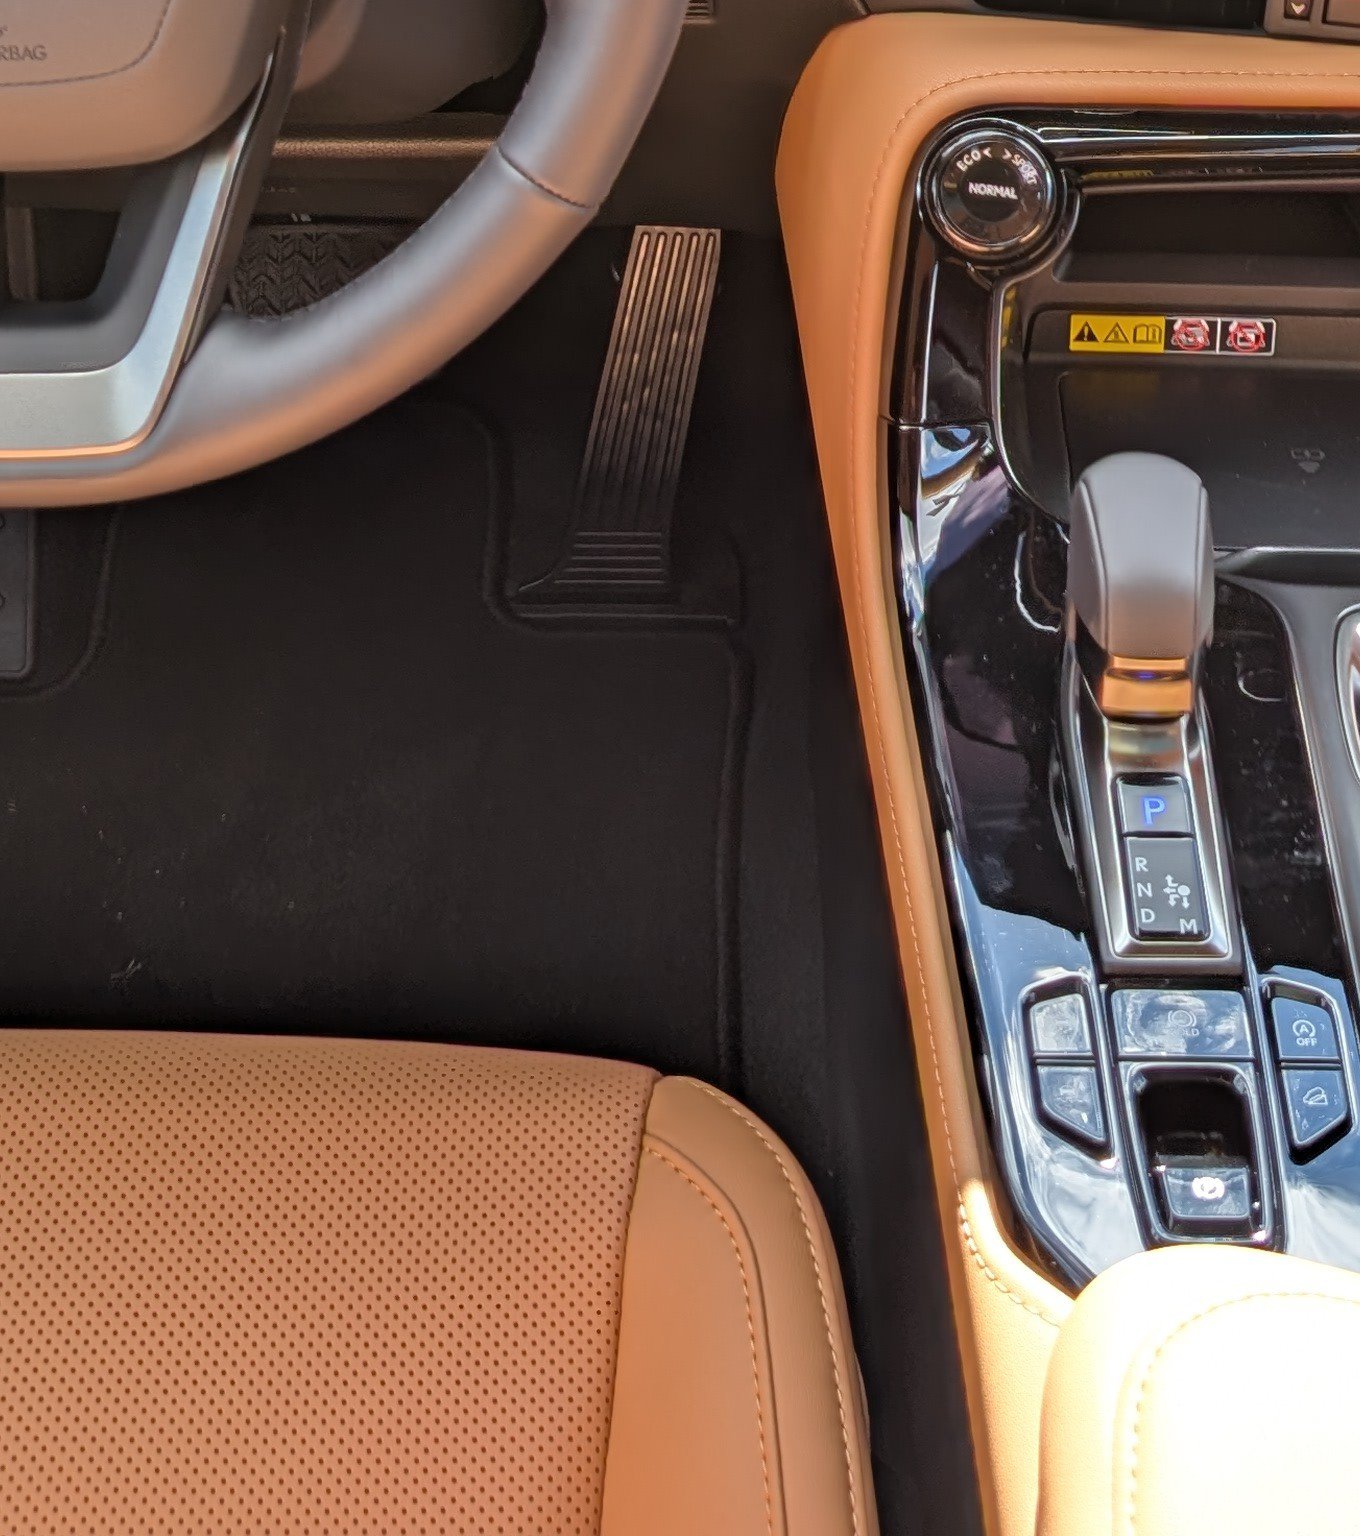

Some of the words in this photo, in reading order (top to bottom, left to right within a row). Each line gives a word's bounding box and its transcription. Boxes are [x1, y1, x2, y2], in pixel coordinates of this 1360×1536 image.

[956, 149, 981, 172] ECO
[1011, 154, 1039, 184] SPORT
[968, 182, 1018, 200] NORMAL
[1143, 797, 1165, 825] P
[1134, 857, 1149, 872] R
[1137, 882, 1153, 898] N
[1141, 908, 1156, 923] D
[1179, 918, 1198, 934] M
[1296, 1037, 1318, 1046] OFF
